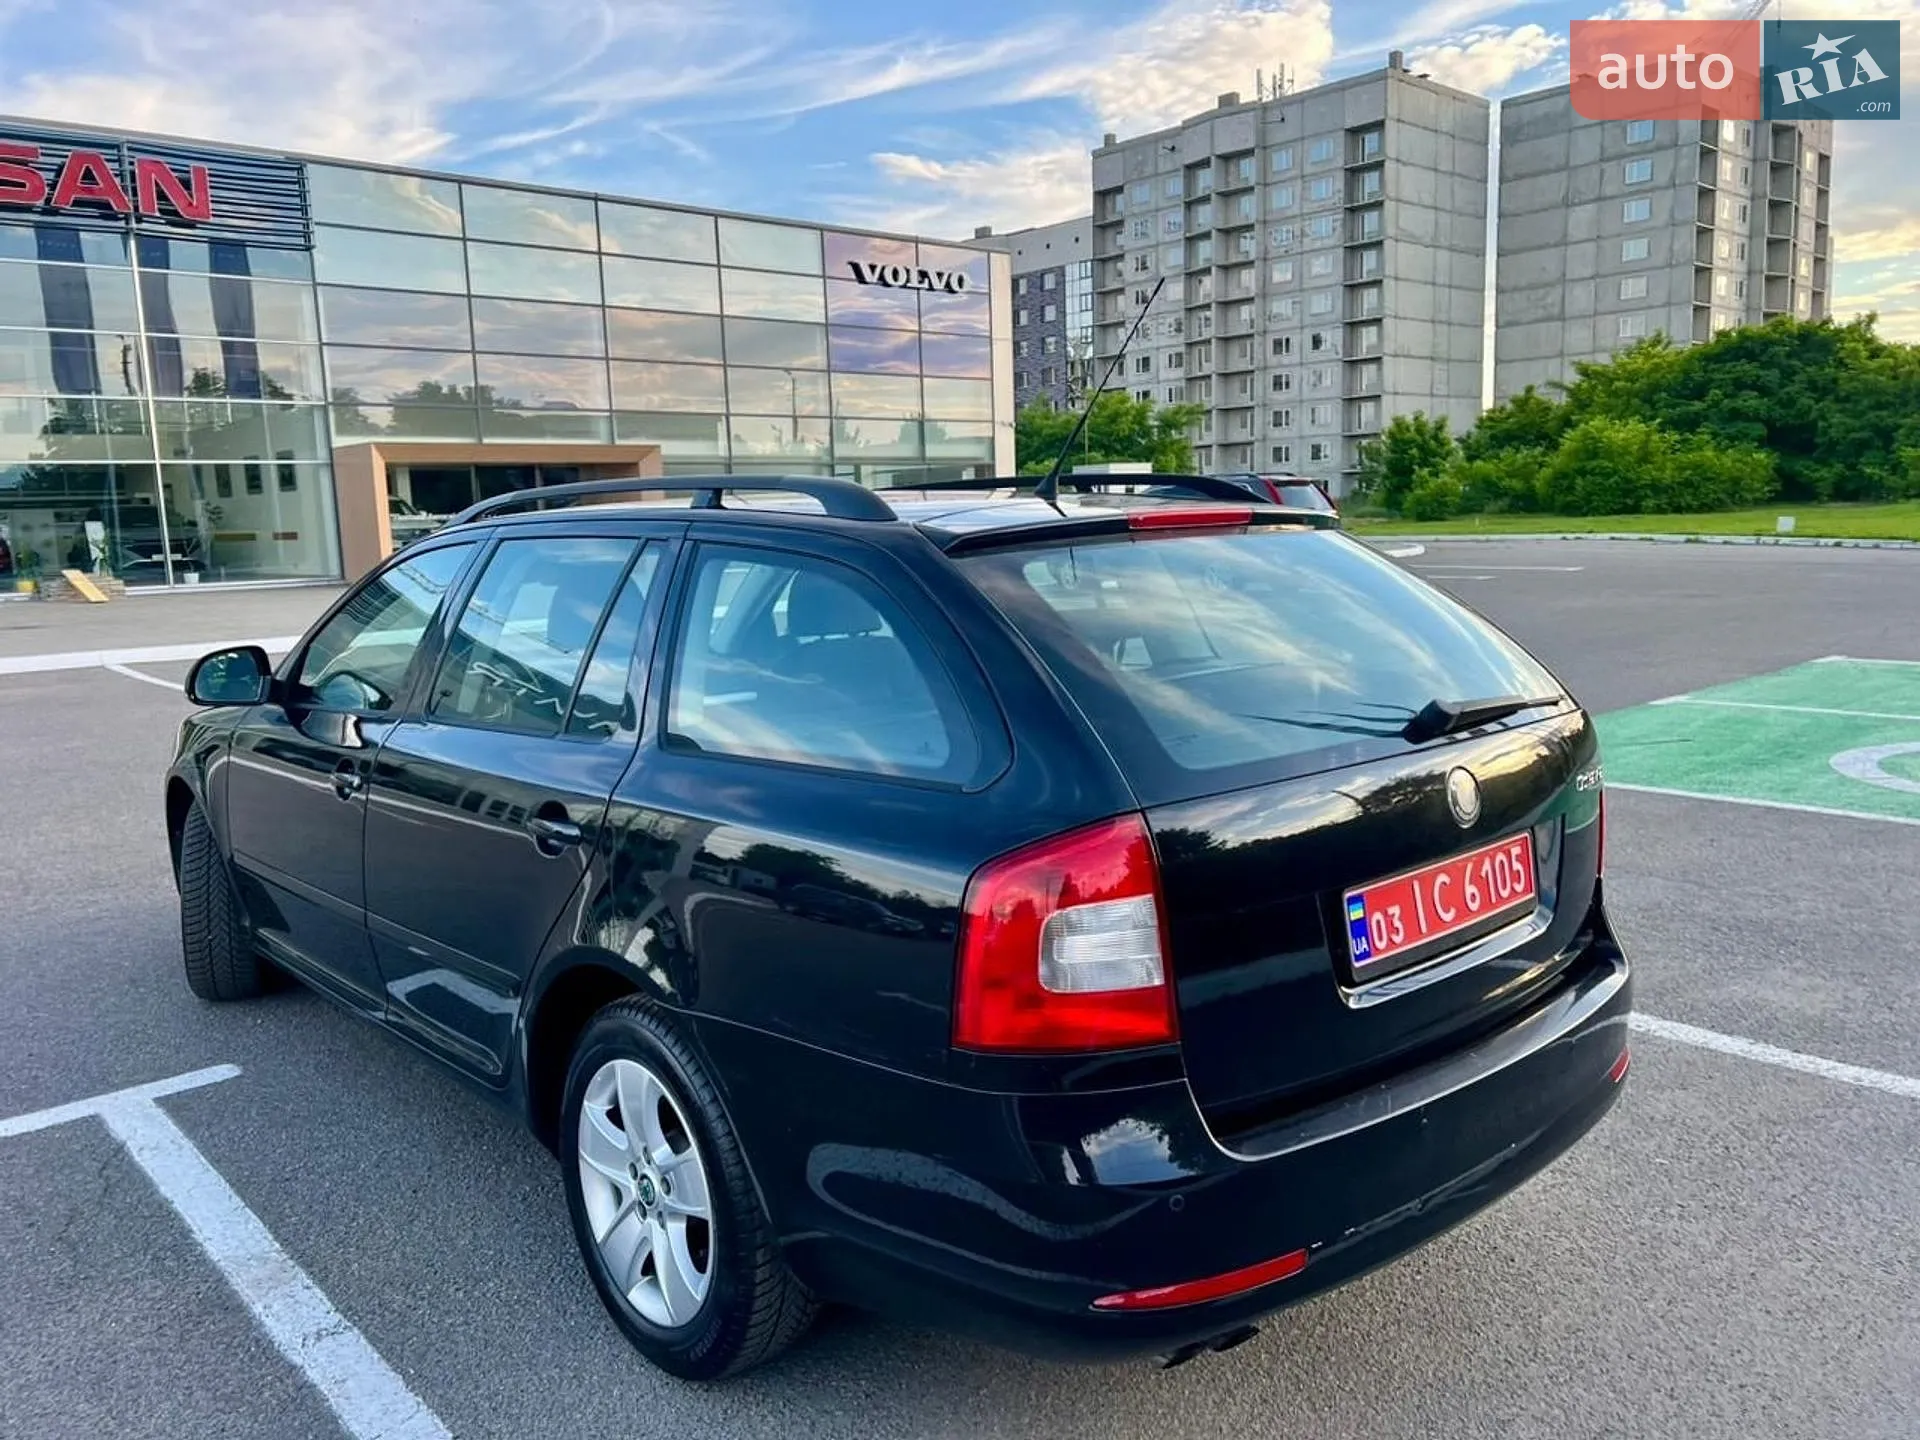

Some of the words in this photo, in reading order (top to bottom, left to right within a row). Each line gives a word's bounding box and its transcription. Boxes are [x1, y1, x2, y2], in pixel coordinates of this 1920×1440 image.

[0, 139, 213, 222] SAN
[848, 261, 972, 294] VOLVO
[1371, 904, 1405, 951] 03
[1412, 873, 1456, 934] IC
[1463, 846, 1526, 912] 6105
[1353, 936, 1369, 955] UA
